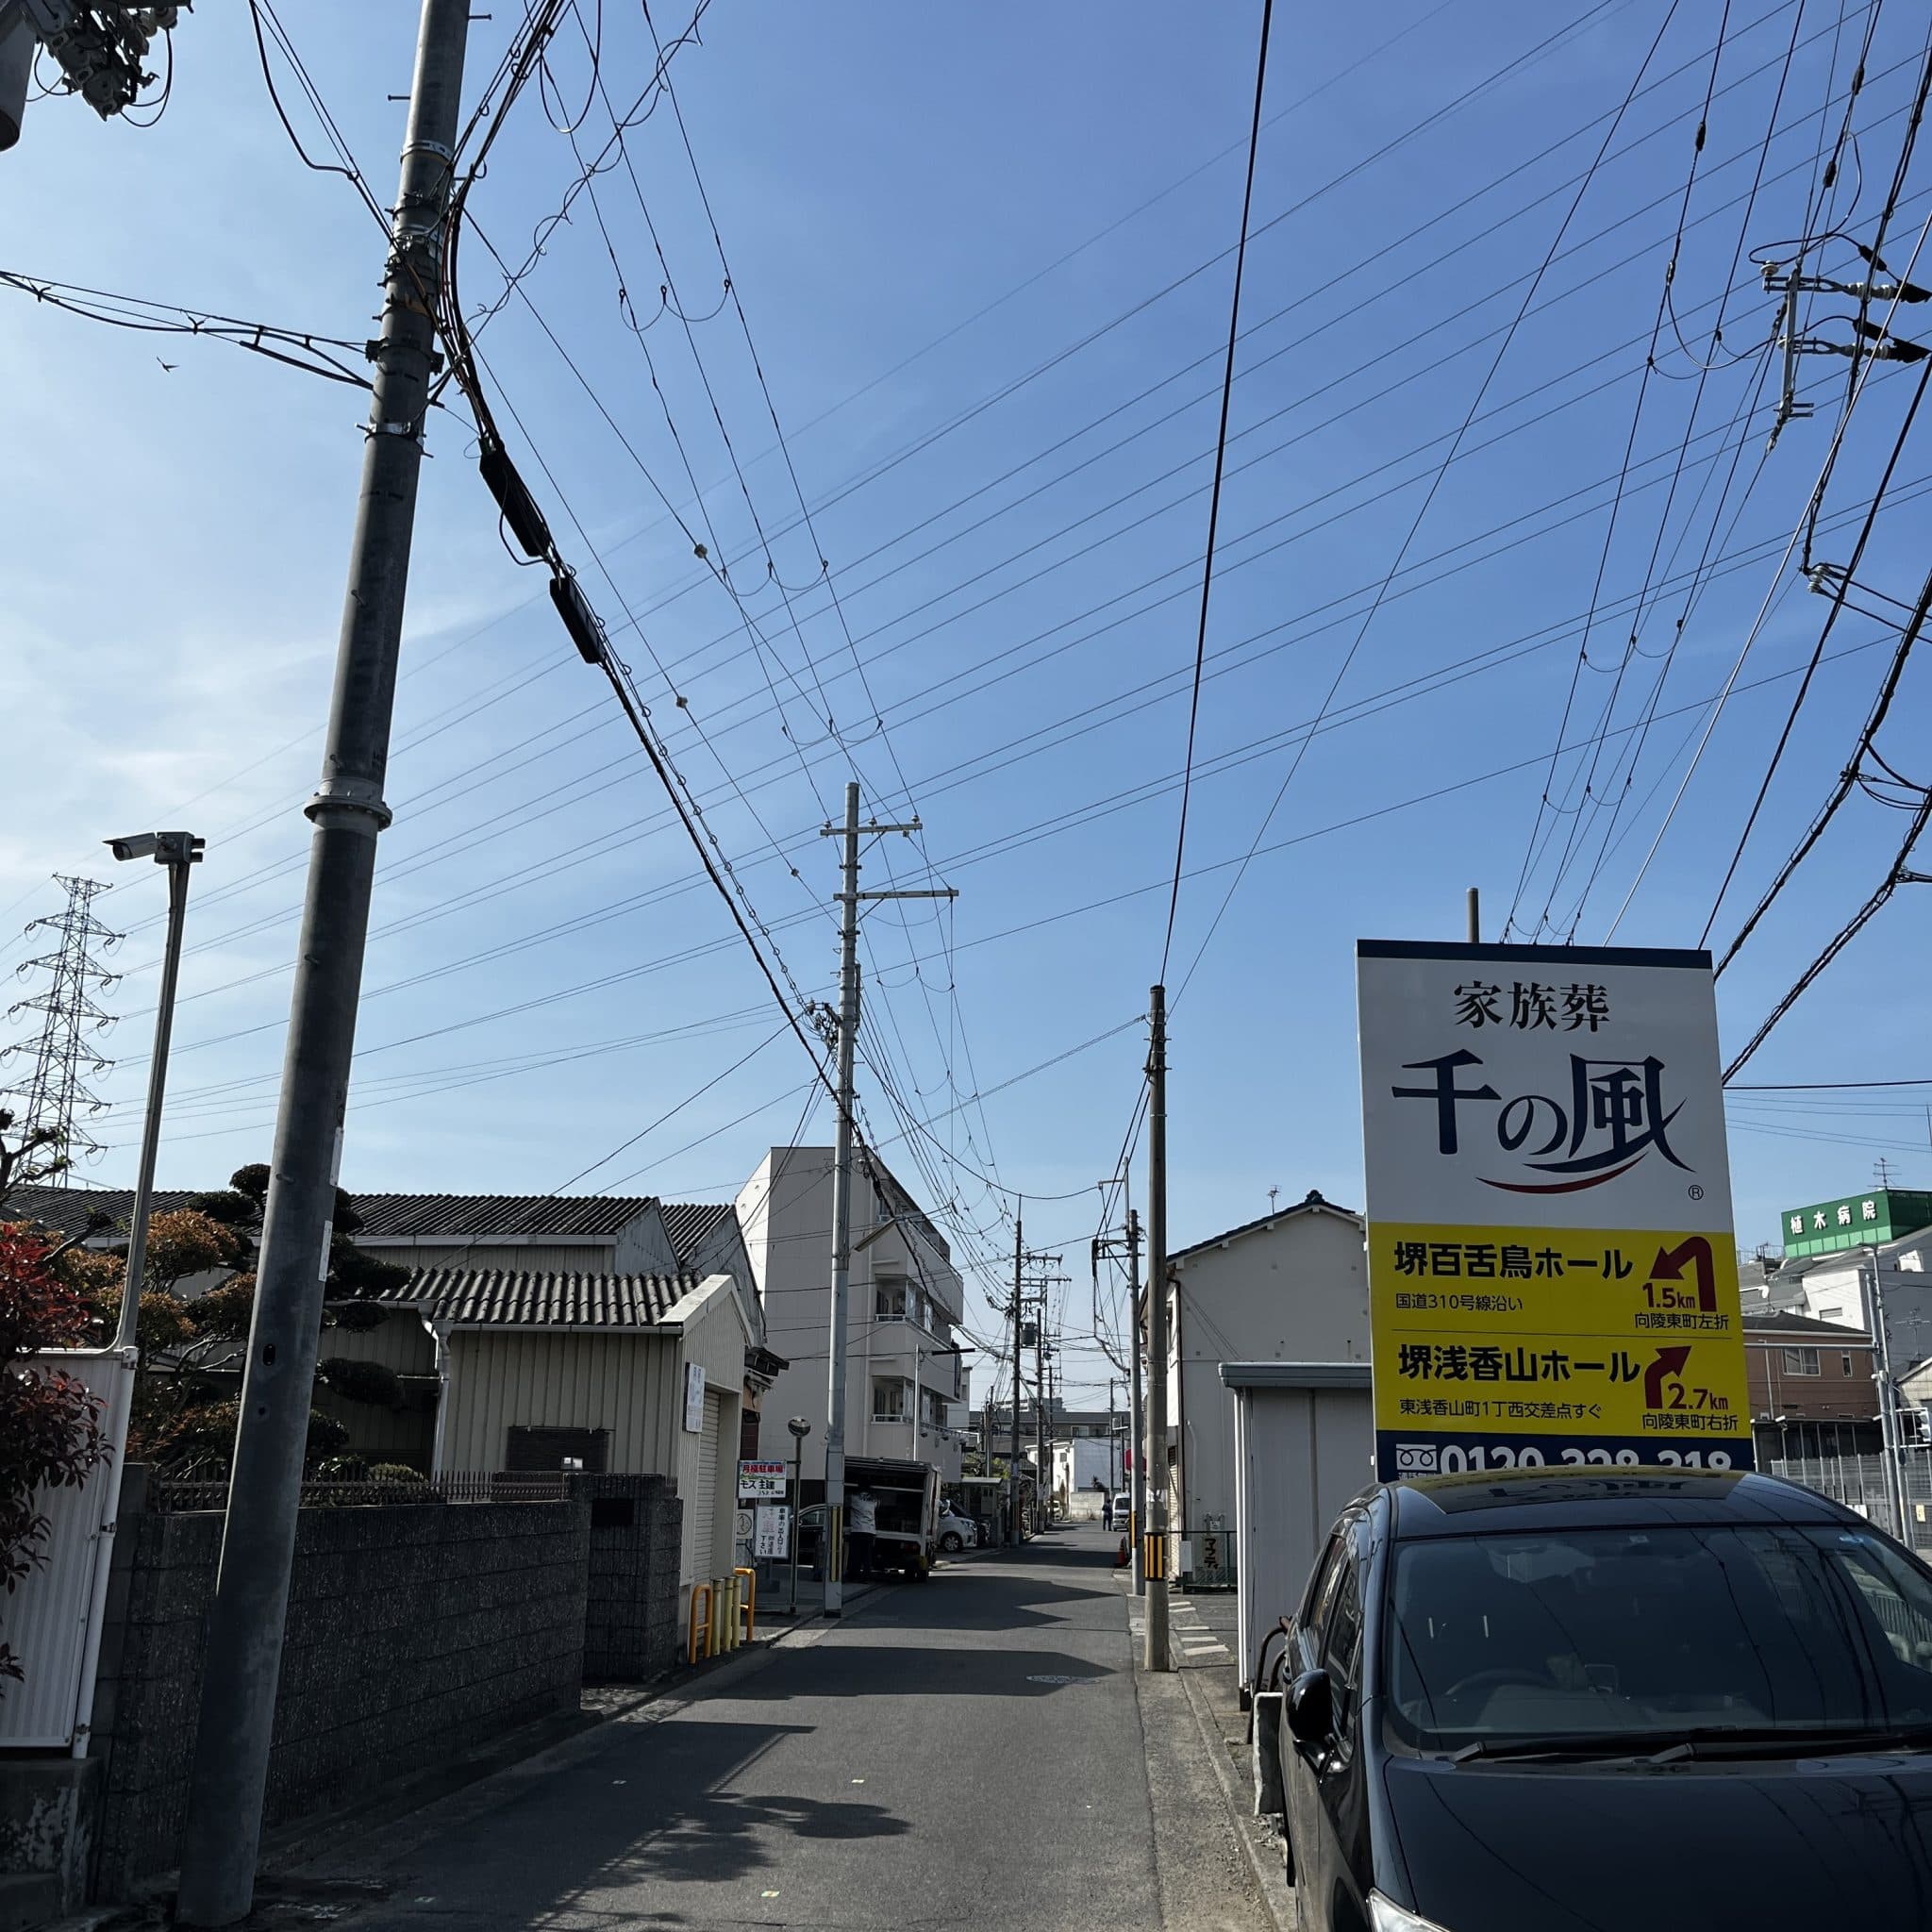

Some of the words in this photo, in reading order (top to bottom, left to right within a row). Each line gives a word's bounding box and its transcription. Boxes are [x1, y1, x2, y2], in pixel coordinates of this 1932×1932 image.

[1454, 981, 1610, 1033] 家族葬
[1391, 1048, 1696, 1174] 千の風
[1790, 1200, 1877, 1236] 植木病院
[1394, 1241, 1633, 1280] 堺百舌鳥ホール
[1396, 1293, 1523, 1311] 国道310号線沿い
[1642, 1282, 1696, 1309] 1.5km
[1635, 1312, 1729, 1330] 向陵東町左折
[1398, 1344, 1641, 1383] 堺浅香山ホール
[1399, 1398, 1602, 1420] 東浅香山町1丁西交差点すぐ
[1667, 1382, 1729, 1410] 2.7km
[1642, 1413, 1739, 1431] 向陵東町右折
